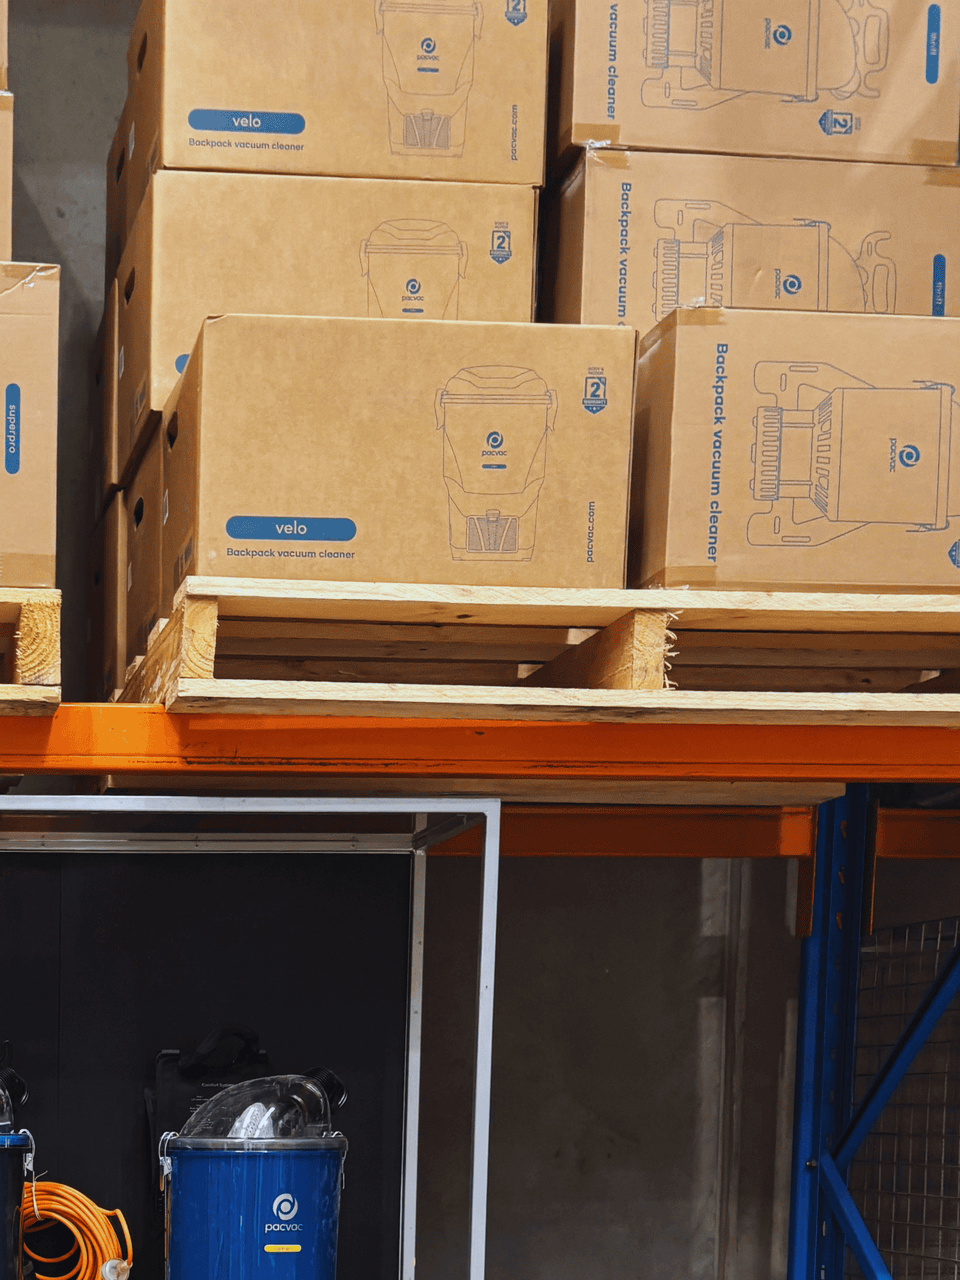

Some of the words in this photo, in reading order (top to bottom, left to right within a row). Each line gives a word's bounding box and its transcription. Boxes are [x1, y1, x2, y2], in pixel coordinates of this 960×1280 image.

[608, 4, 618, 63] vacuum
[232, 113, 261, 128] velo
[606, 65, 617, 121] cleaner
[188, 138, 232, 148] Backpack
[234, 141, 270, 149] vacuum
[271, 142, 304, 151] cleaner
[617, 182, 632, 255] Backpack
[617, 258, 628, 319] vacuum
[711, 343, 728, 426] Backpack
[6, 404, 17, 454] superpro
[888, 438, 897, 472] pacvac
[710, 429, 723, 496] vacuum
[226, 548, 275, 558] Backpack
[277, 550, 316, 558] vacuum
[318, 550, 355, 558] cleaner
[276, 520, 307, 535] velo
[586, 501, 595, 563] pacvac.com
[707, 500, 722, 562] cleaner
[265, 1224, 303, 1233] pacvac
